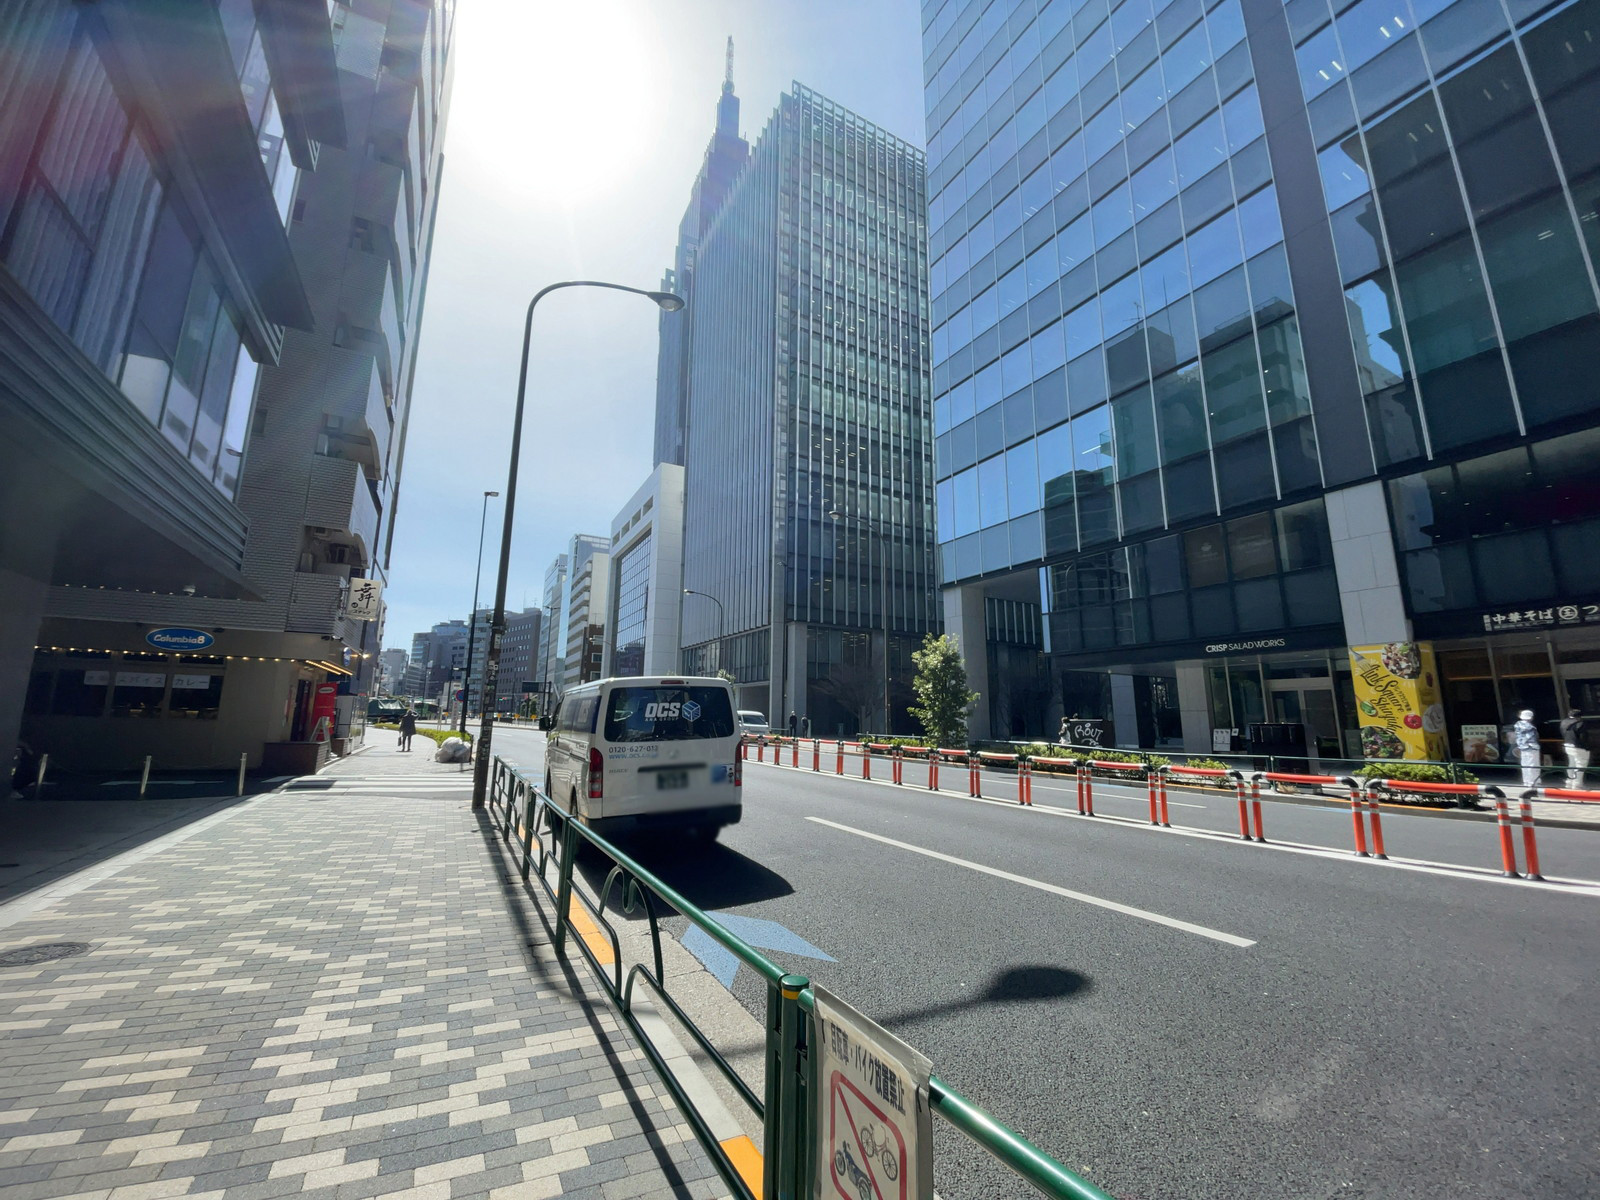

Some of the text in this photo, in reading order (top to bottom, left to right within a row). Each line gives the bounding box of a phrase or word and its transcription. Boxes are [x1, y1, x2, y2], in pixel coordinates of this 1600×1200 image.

[1492, 607, 1554, 625] 中華そば
[1205, 638, 1286, 653] CRISP SALAD WORKS
[174, 677, 209, 686] カレー
[1360, 663, 1390, 687] Link
[1374, 680, 1405, 713] Square
[644, 702, 681, 718] OCS
